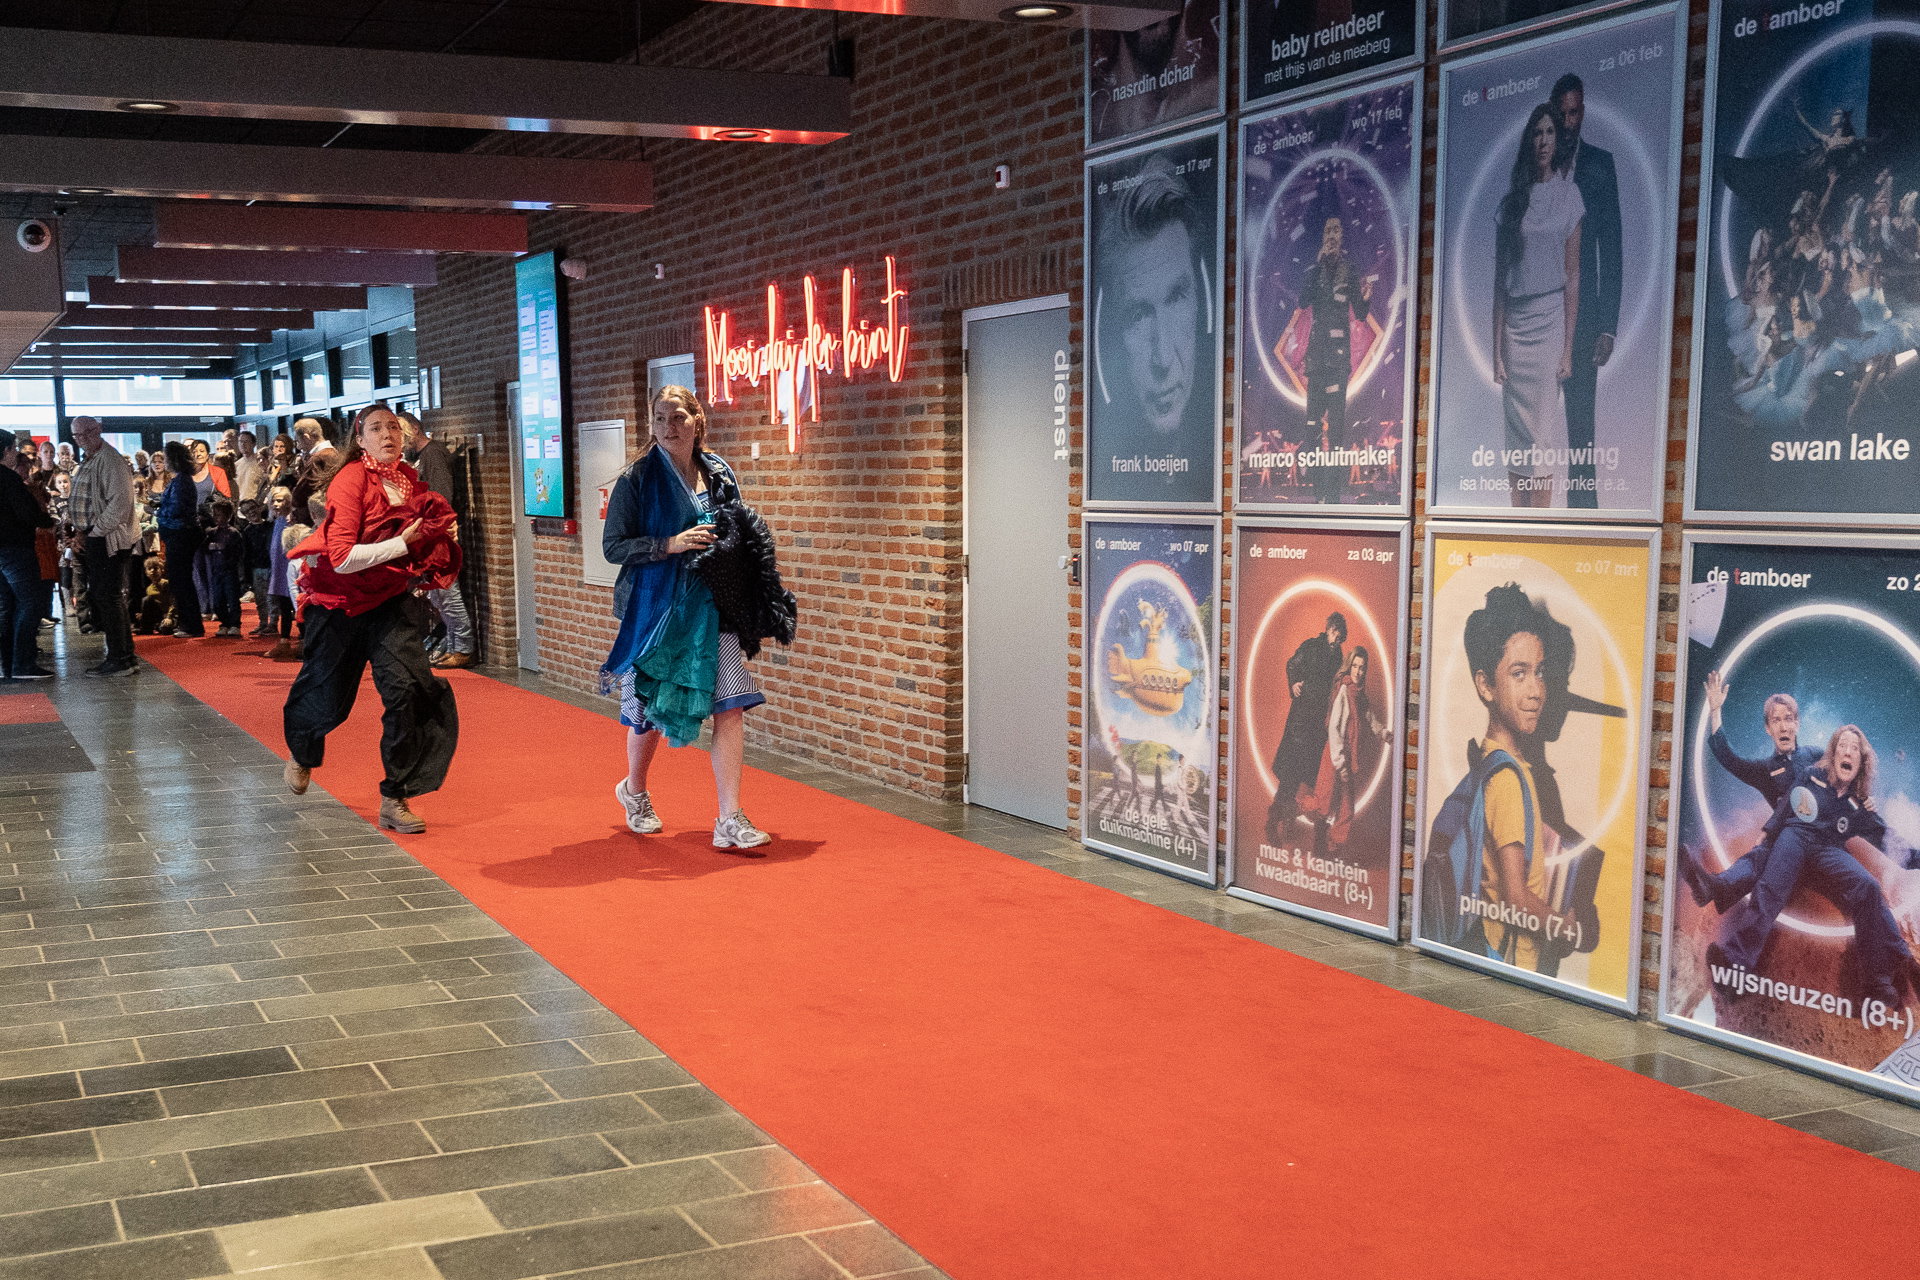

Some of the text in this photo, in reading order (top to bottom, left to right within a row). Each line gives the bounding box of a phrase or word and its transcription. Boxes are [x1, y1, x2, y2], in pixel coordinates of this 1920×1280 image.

[1271, 10, 1386, 62] baby reindeer
[1734, 17, 1757, 38] de
[1264, 36, 1391, 85] met thijs van de meeberg
[1599, 42, 1664, 72] za 06 feb
[1112, 63, 1196, 102] nasrdin dchar
[1462, 88, 1478, 107] de
[1352, 115, 1368, 130] wo
[1385, 104, 1403, 122] feb
[1253, 130, 1314, 156] de amboer
[1176, 157, 1213, 176] za 17 apr
[1097, 174, 1144, 196] de amboer
[705, 305, 760, 406] Mooi
[842, 256, 910, 383] bint
[1053, 349, 1070, 461] dienst
[1249, 446, 1395, 469] marco schuitmaker
[1472, 442, 1620, 471] de verbouwing
[1770, 432, 1910, 463] swan lake
[1112, 455, 1189, 475] frank boeijen
[1459, 476, 1477, 491] isa
[1517, 475, 1554, 491] edwin
[1557, 475, 1598, 495] jonker
[1095, 537, 1106, 550] de
[1170, 541, 1209, 555] wo 07 apr
[1250, 543, 1308, 560] de amboer
[1347, 548, 1394, 564] za 03 apr
[1447, 551, 1524, 570] de tamboer
[1575, 560, 1639, 577] zo 07 mrt
[1707, 566, 1812, 588] de tamboer
[1886, 576, 1910, 591] zo
[1124, 808, 1168, 832] de gele
[1099, 817, 1198, 861] duikmachine (4+)
[1259, 843, 1369, 885] mus & kapitein
[1255, 858, 1373, 910] kwaadbaart (8+)
[1460, 894, 1582, 949] pinokkio (7+)
[1711, 963, 1914, 1040] wijsneuzen (8+)
